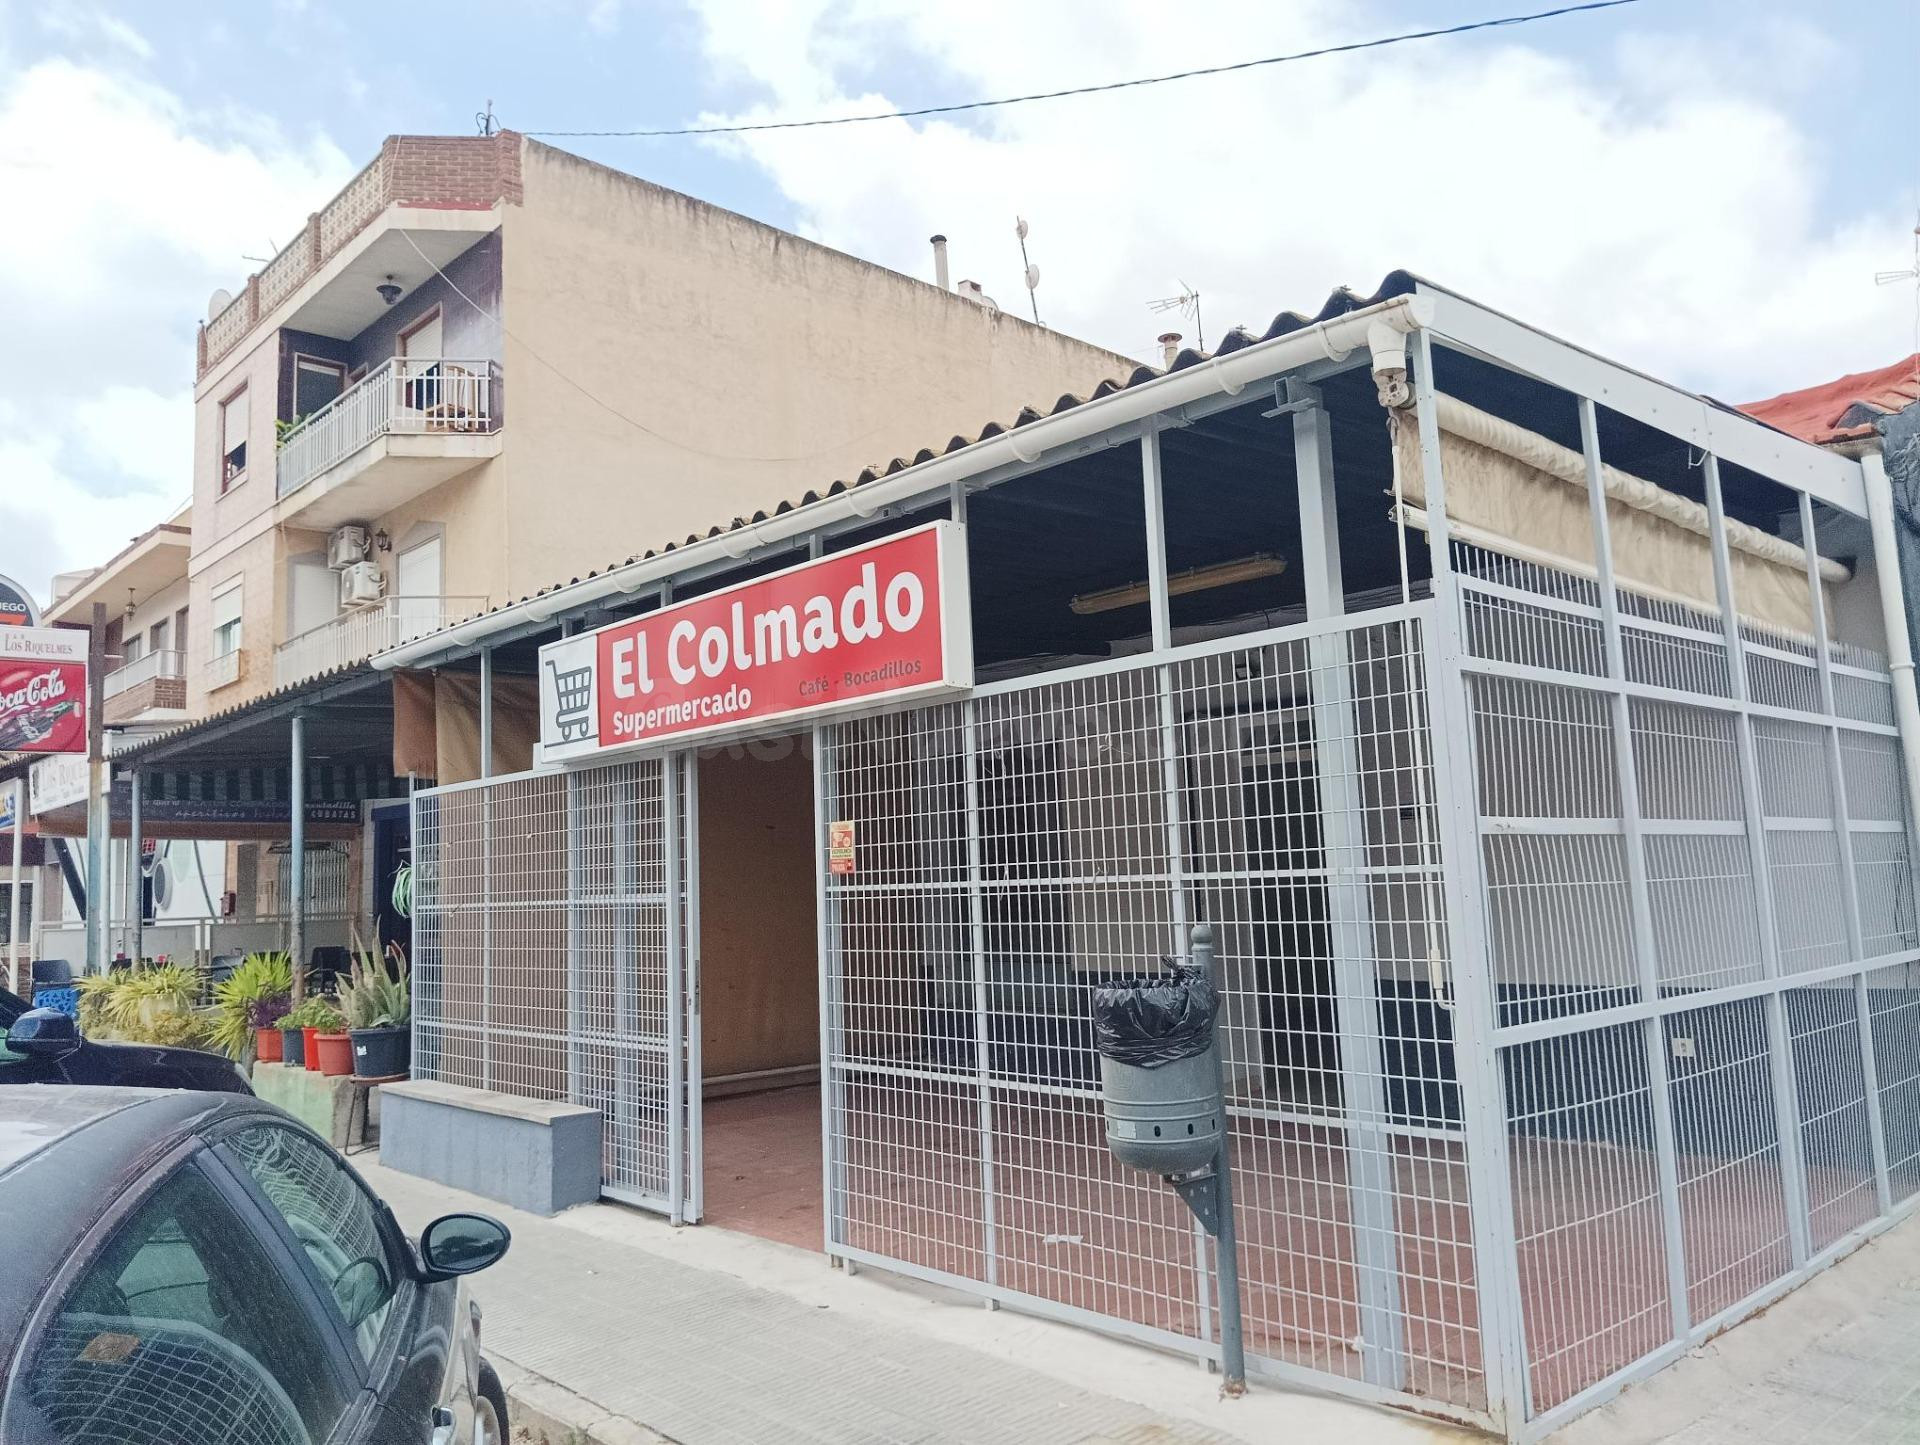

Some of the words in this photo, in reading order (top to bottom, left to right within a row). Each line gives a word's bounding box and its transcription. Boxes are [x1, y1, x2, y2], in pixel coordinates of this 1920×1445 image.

[0, 602, 26, 612] EGO
[612, 630, 655, 699] El
[667, 562, 925, 685] Colmado
[799, 674, 829, 696] Café
[844, 660, 922, 689] Bocadillos
[613, 683, 752, 738] Supermercado
